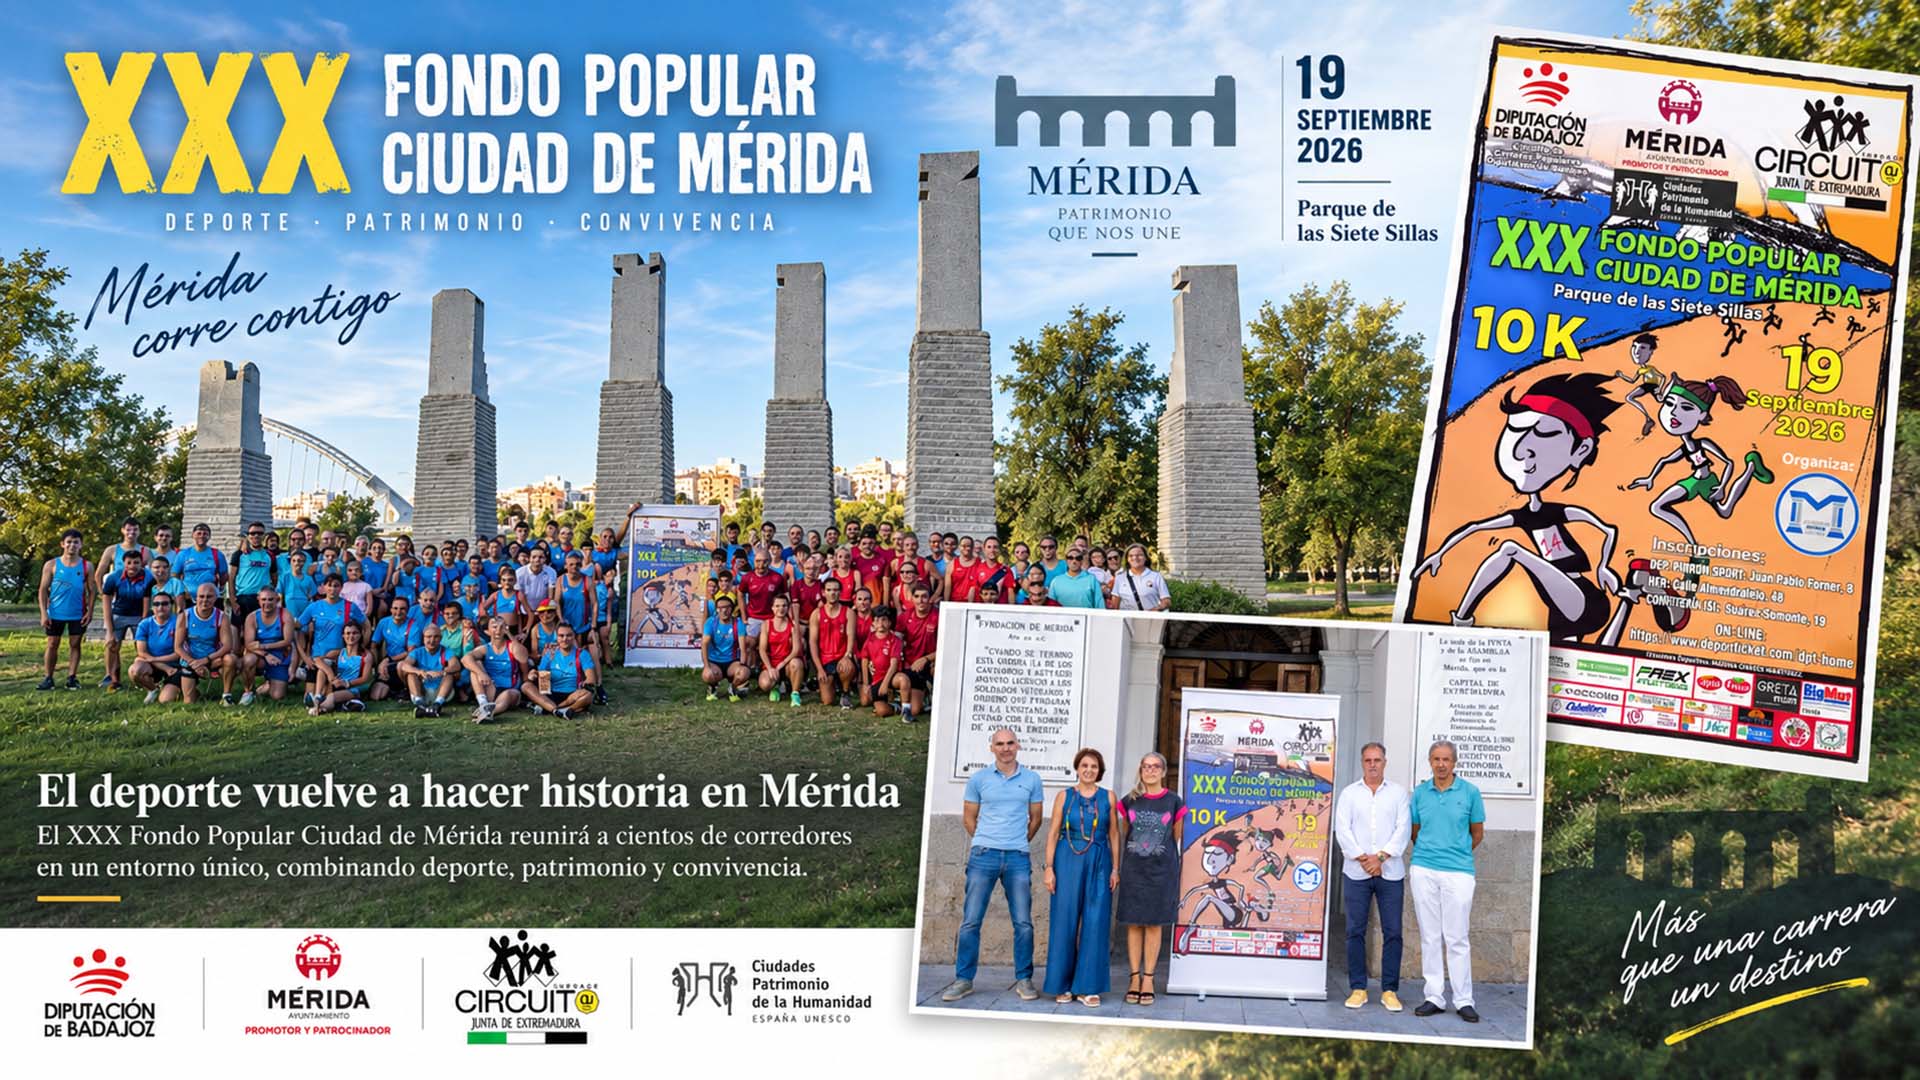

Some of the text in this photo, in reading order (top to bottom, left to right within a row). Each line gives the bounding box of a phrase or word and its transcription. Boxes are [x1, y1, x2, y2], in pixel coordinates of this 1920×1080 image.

[1495, 109, 1587, 132] DIPUTACIÓN
[1493, 126, 1585, 147] DE BADAJOZ
[1625, 128, 1727, 159] MÉRIDA
[1775, 176, 1881, 197] JUNTA DE EXTREMADURA
[1490, 216, 1590, 276] XXX
[1600, 228, 1842, 276] FONDO POPULAR
[1595, 258, 1862, 309] CIUDAD DE MÉRIDA
[1553, 284, 1763, 321] Parque de las Siete Sillas
[1472, 305, 1588, 362] 10 K
[1781, 346, 1843, 394] 19
[1746, 389, 1875, 420] Septiembre
[1774, 415, 1846, 442] 2026
[1782, 452, 1855, 472] Organiza:
[1652, 536, 1767, 564] Inscripciones:
[1749, 570, 1774, 584] Juan
[1776, 573, 1805, 588] Pablo
[1771, 591, 1784, 603] 48
[1029, 623, 1041, 631] DE
[1814, 615, 1827, 628] 19
[1757, 680, 1798, 697] GRETA
[1192, 774, 1227, 795] XXX
[1190, 809, 1228, 825] 10 K
[1296, 815, 1317, 832] 19
